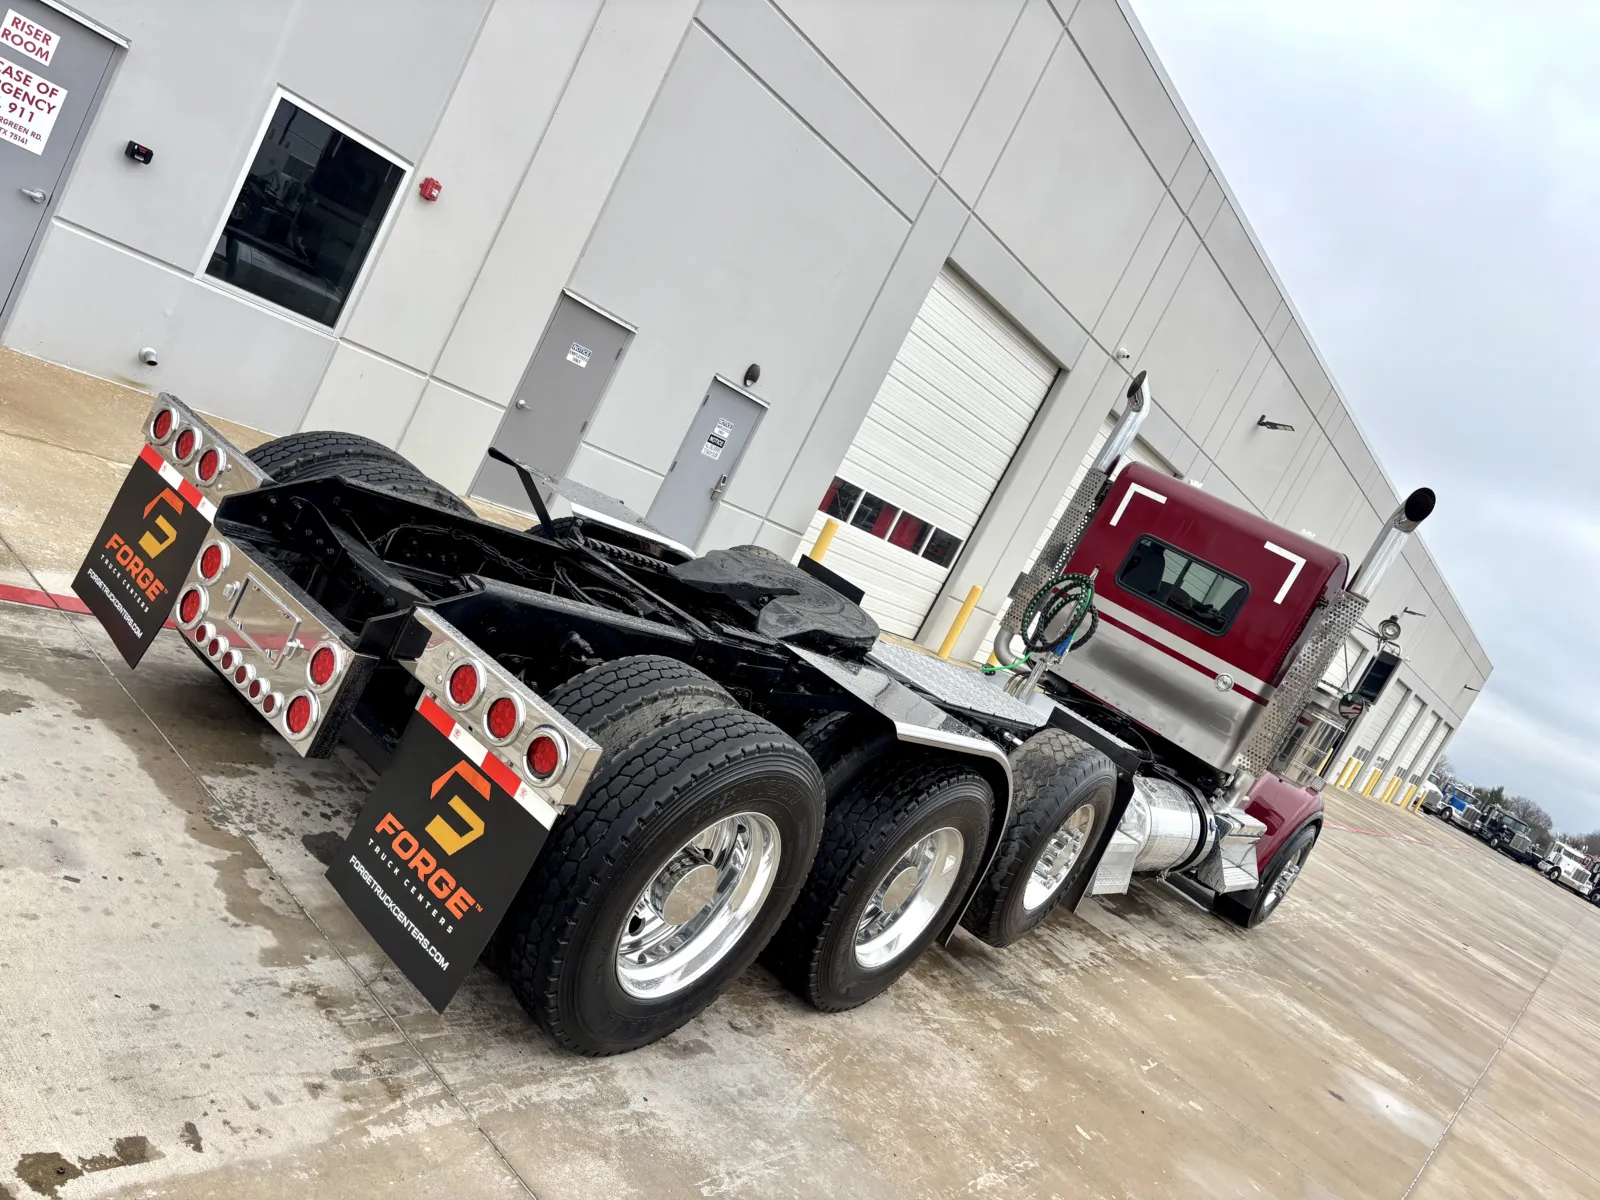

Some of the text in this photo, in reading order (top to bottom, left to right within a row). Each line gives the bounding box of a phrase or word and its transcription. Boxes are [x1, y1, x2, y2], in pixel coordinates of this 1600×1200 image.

[1, 28, 50, 61] ROOM
[11, 16, 52, 46] RISER
[0, 80, 56, 115] GENCY
[36, 82, 59, 98] OF
[8, 102, 35, 122] 911
[9, 131, 28, 145] 75141
[100, 554, 149, 613] TRUCK CENTERS
[87, 568, 143, 639] FORGETRUCKCENTERS.COM
[368, 838, 454, 934] TRUCK CENTERS
[349, 855, 450, 971] FORGETRUCKCENTERS.COM
